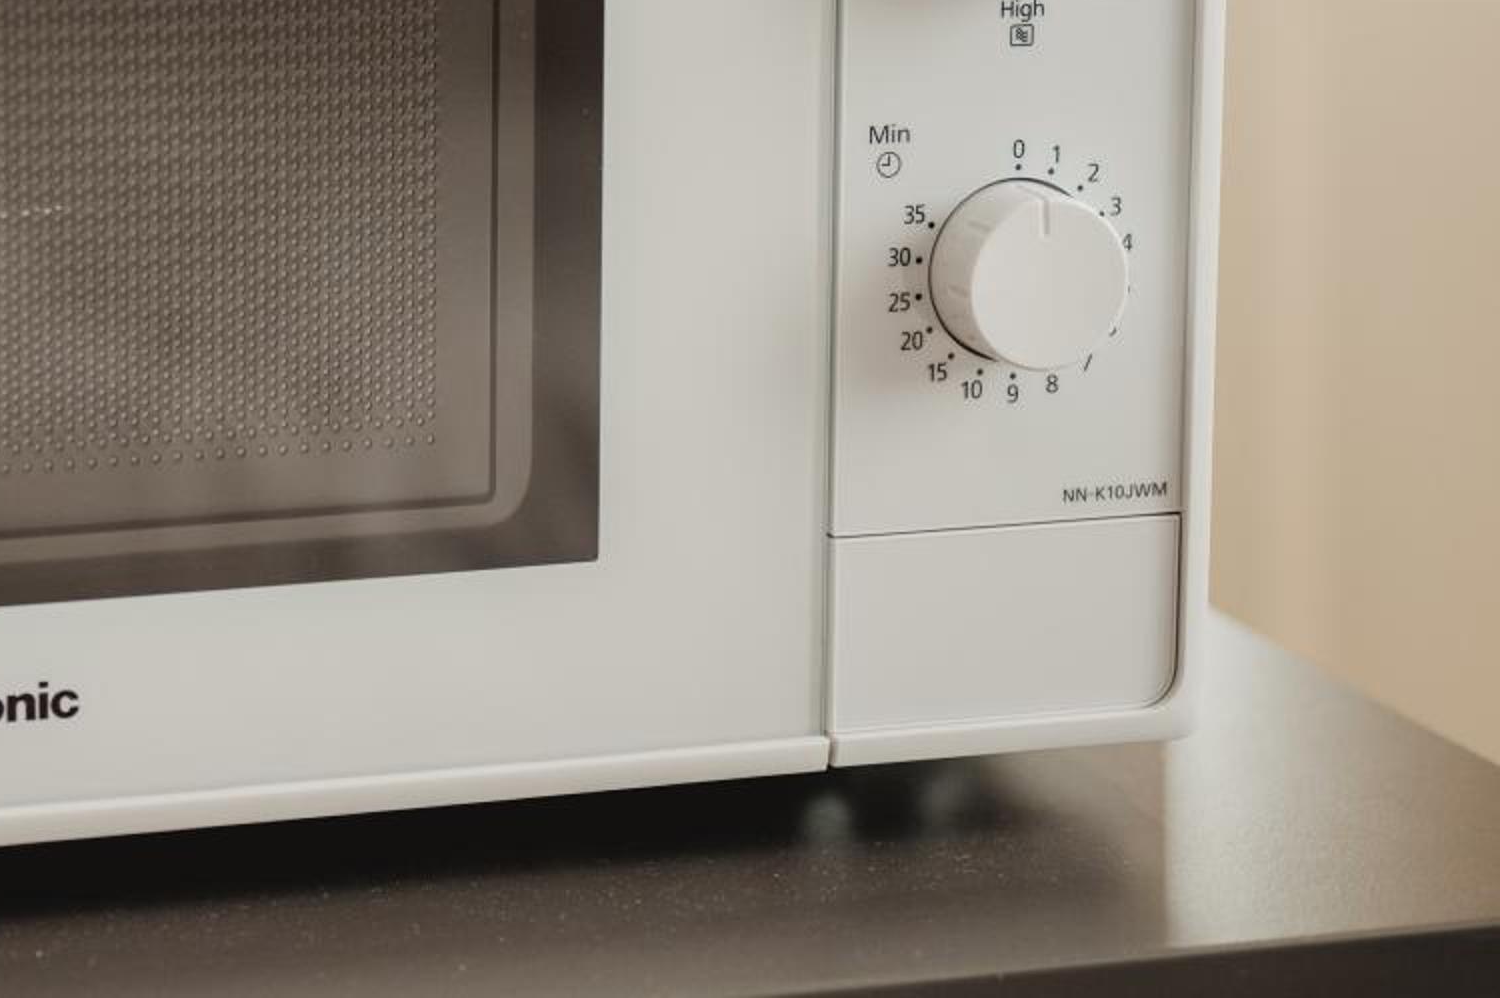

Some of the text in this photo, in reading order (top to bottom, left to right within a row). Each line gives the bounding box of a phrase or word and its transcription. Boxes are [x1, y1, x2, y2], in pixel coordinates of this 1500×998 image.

[869, 123, 911, 145] Min
[1012, 138, 1026, 159] 0
[1052, 144, 1061, 164] 1
[1087, 162, 1100, 183] 2
[903, 203, 926, 225] 35
[1110, 196, 1122, 217] 3
[1122, 233, 1133, 251] 4
[888, 246, 912, 268] 30
[888, 291, 911, 313] 25
[900, 330, 924, 352] 20
[927, 361, 948, 382] 15
[960, 379, 983, 400] 10
[1006, 383, 1019, 404] 9
[1045, 374, 1059, 394] 8
[1062, 481, 1169, 503] NN-K10JWM
